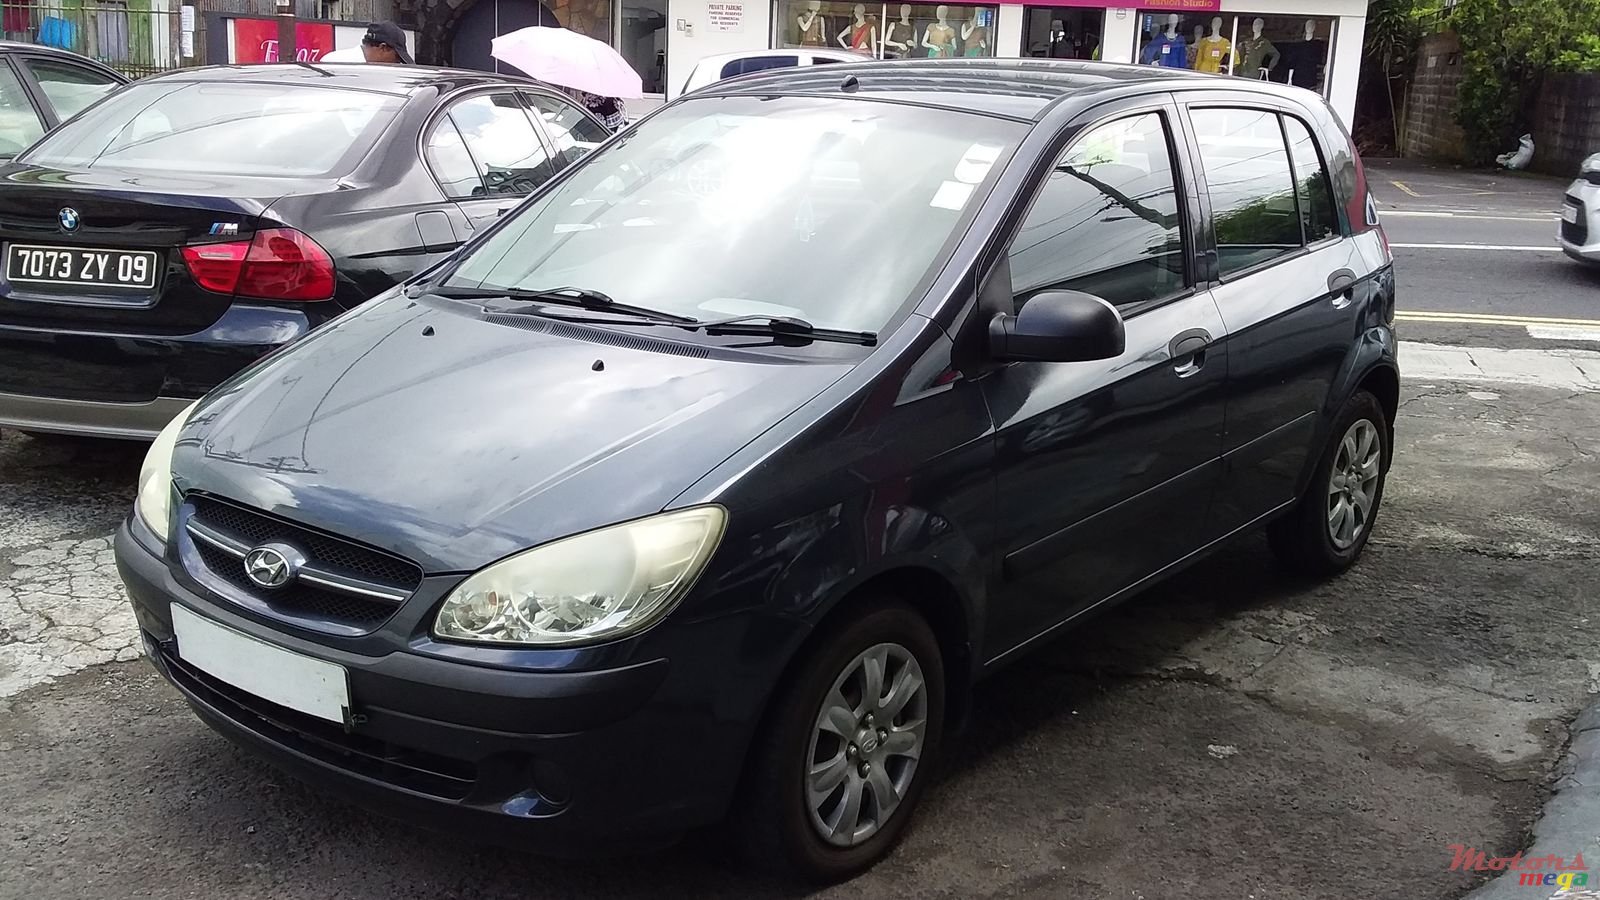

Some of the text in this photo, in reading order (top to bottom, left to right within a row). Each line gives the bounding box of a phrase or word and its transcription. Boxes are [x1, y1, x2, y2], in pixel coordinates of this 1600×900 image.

[18, 250, 148, 282] 7073 ZY 09
